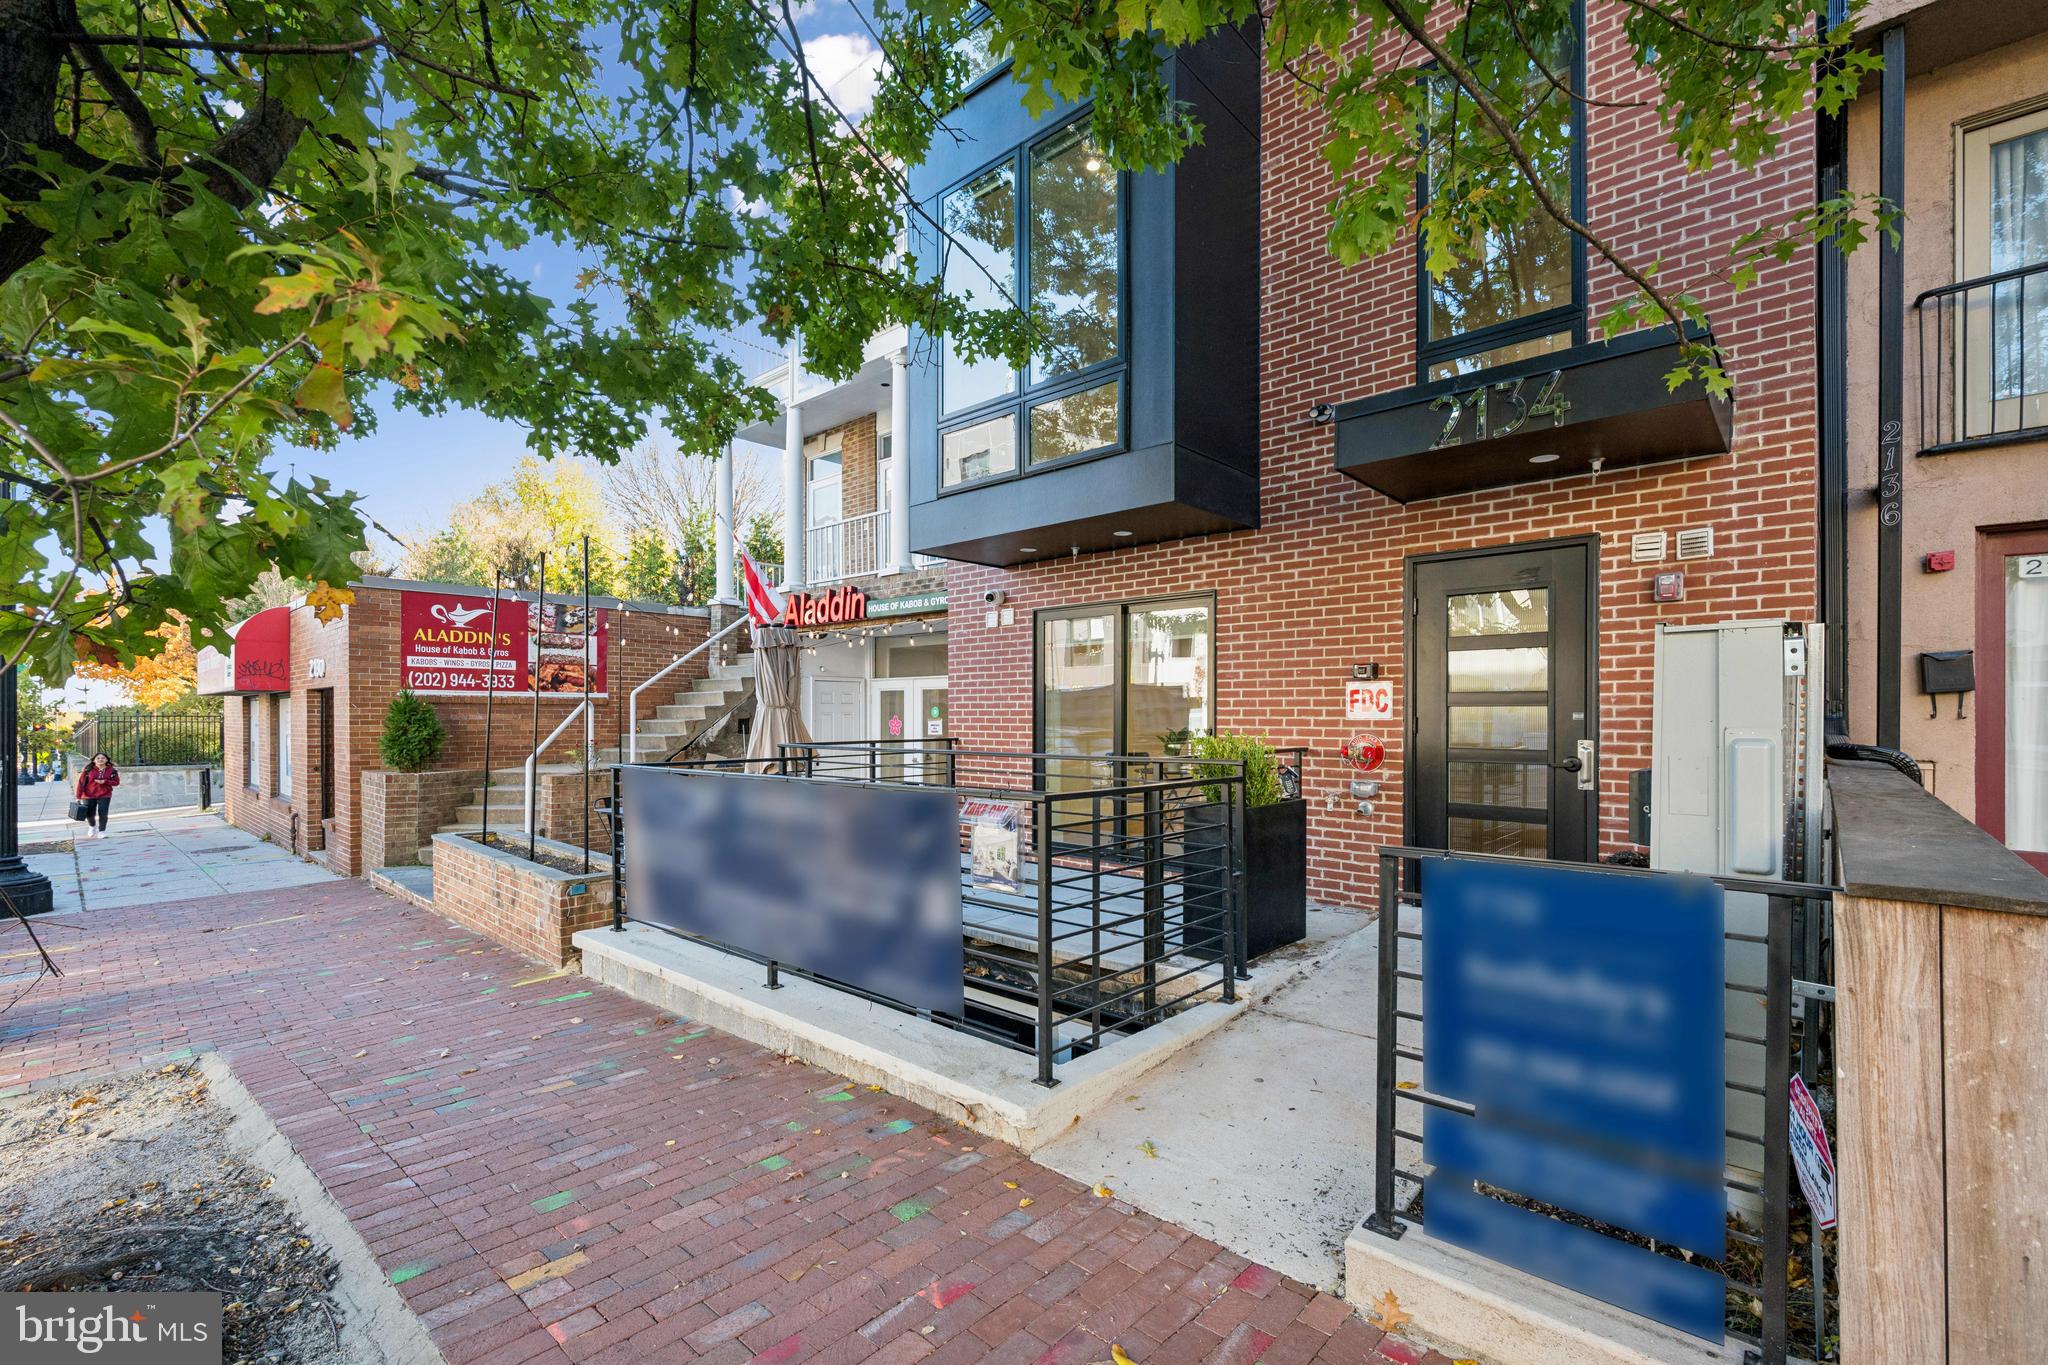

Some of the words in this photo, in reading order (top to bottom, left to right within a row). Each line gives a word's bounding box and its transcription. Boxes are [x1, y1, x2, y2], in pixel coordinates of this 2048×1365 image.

[1429, 370, 1572, 450] 2134
[1880, 420, 1901, 526] 2136
[2025, 559, 2048, 575] 2
[784, 585, 865, 626] Aladdin
[868, 602, 889, 613] HOUSE
[890, 601, 899, 610] OF
[900, 599, 923, 609] KABOB
[924, 598, 929, 607] &
[414, 628, 511, 646] ALADDIN'S
[415, 644, 440, 654] House
[442, 645, 451, 654] of
[453, 646, 478, 656] Kabob
[479, 647, 486, 656] &
[488, 647, 509, 658] Gyros
[411, 658, 438, 666] KABOBS
[444, 659, 465, 667] WINGS
[496, 661, 513, 669] PIZZA
[408, 671, 447, 688] (202)
[450, 673, 515, 688] 944-3933
[1349, 688, 1388, 713] FDC
